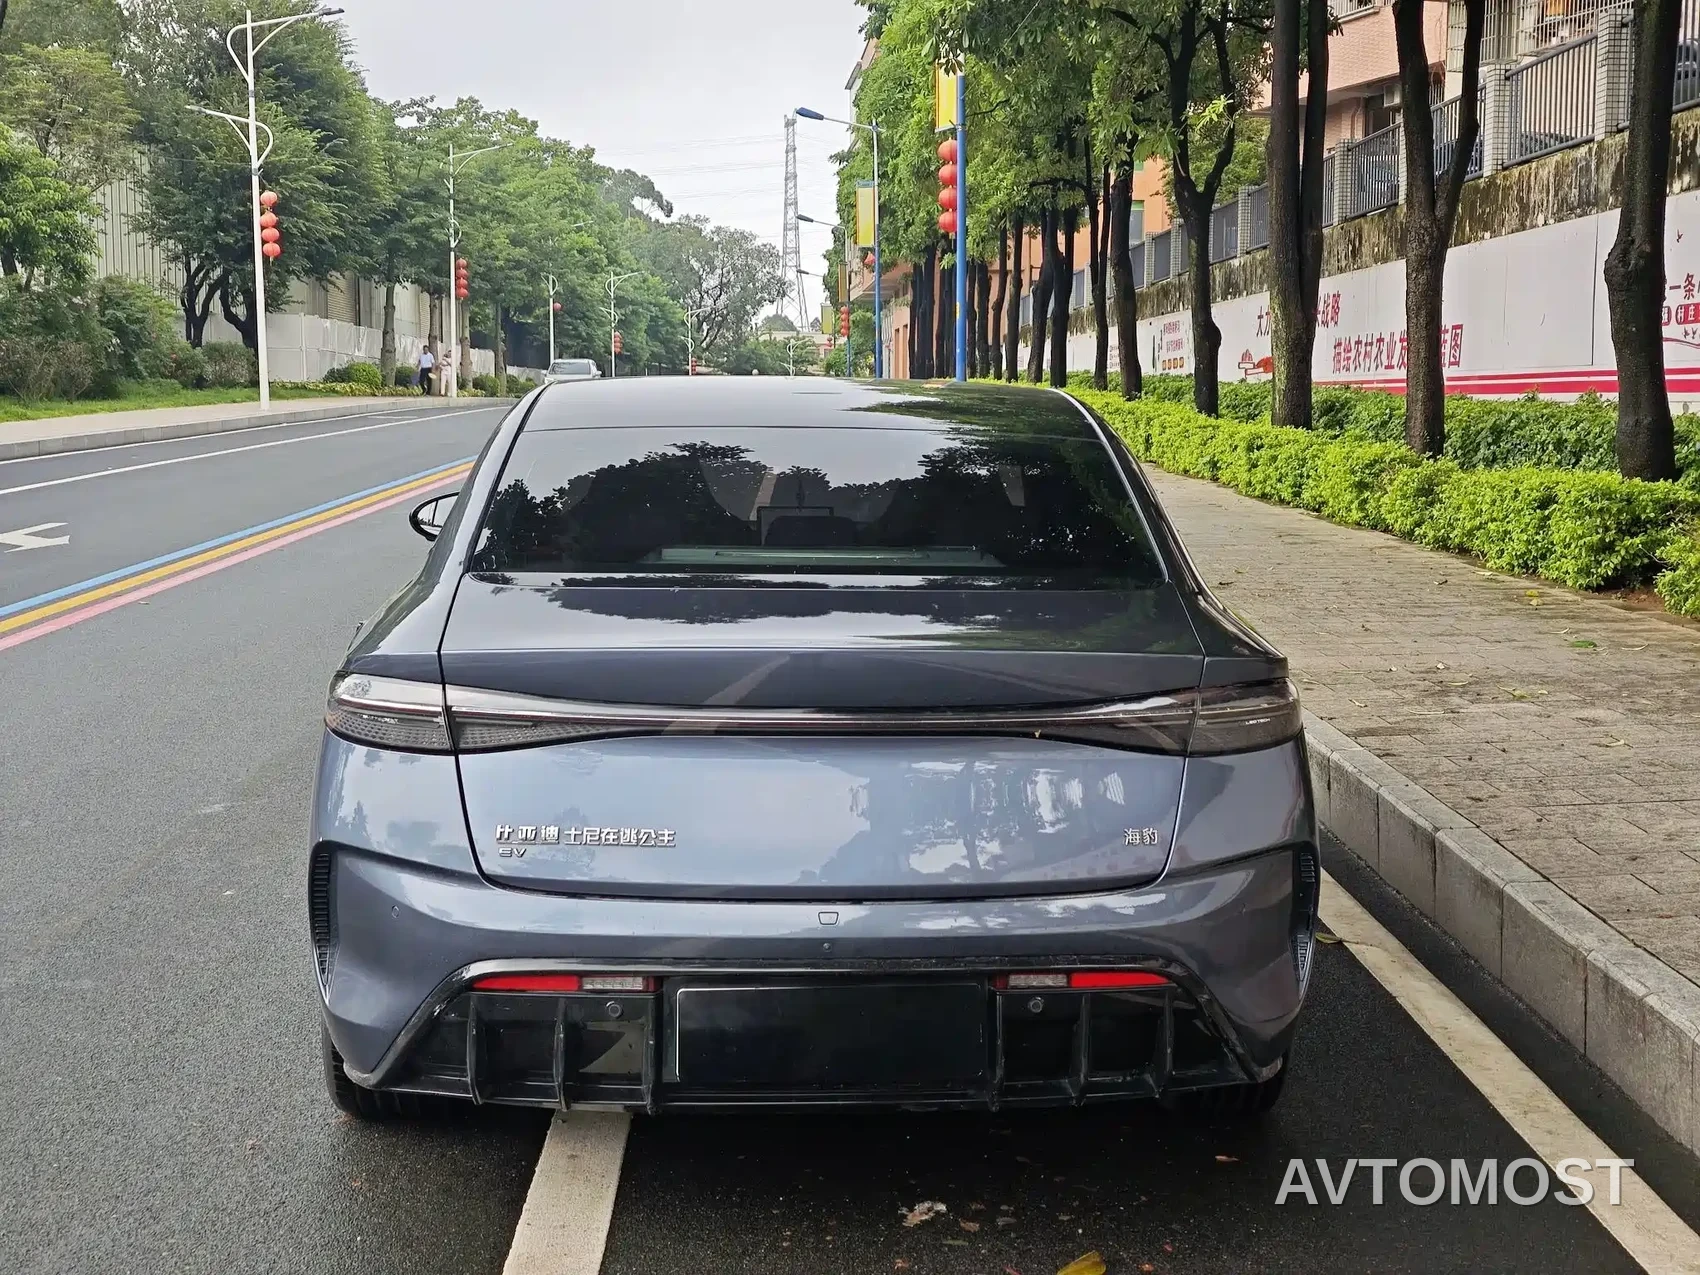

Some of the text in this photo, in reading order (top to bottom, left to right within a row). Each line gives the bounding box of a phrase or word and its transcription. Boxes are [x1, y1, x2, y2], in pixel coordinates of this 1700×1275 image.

[1669, 273, 1700, 300] 一条
[1123, 827, 1158, 846] 海豹
[499, 847, 527, 858] EV
